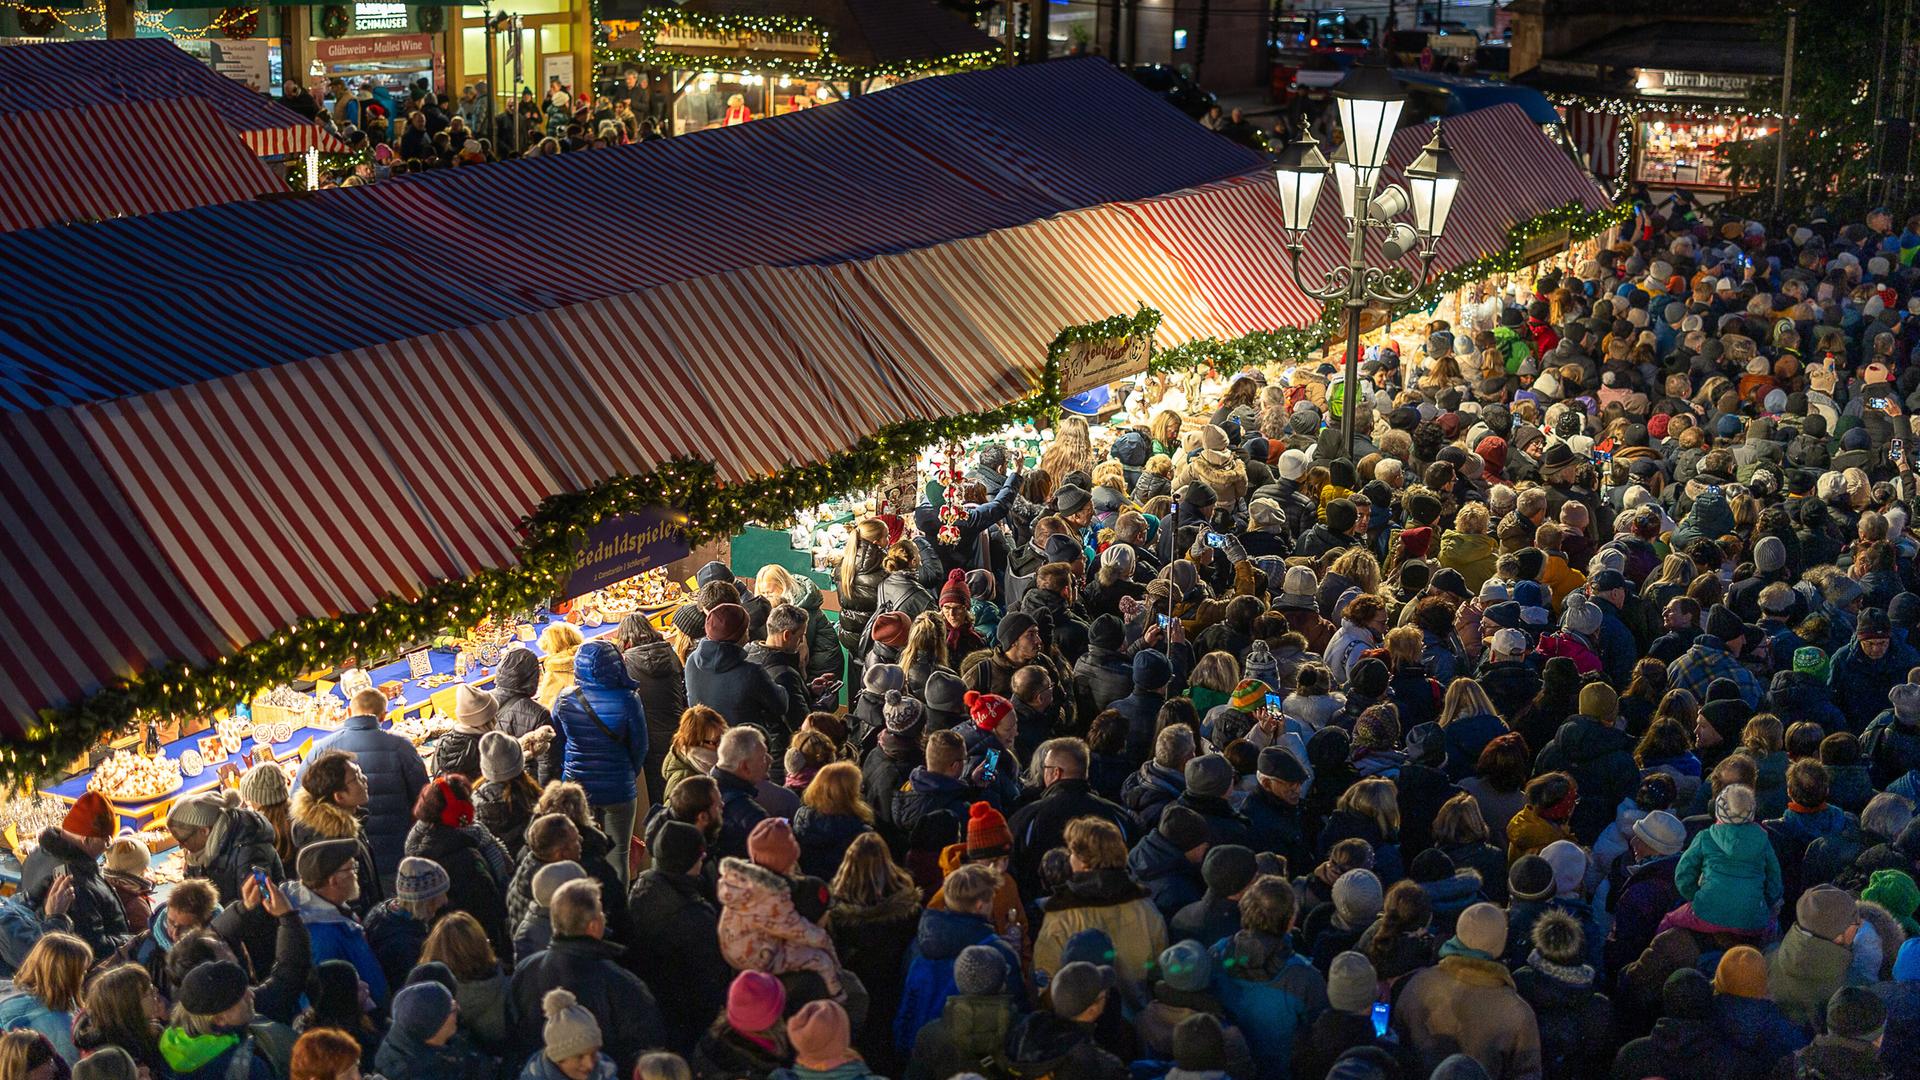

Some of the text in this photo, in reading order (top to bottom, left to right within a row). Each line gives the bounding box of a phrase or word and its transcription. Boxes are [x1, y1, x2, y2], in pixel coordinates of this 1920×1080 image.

[355, 18, 408, 30] SCHMAUSER
[328, 44, 366, 56] Glühwein
[374, 41, 400, 53] Mulled
[401, 40, 423, 51] Wine
[1663, 71, 1748, 90] Nürnberger
[575, 519, 672, 570] Geduldspiele
